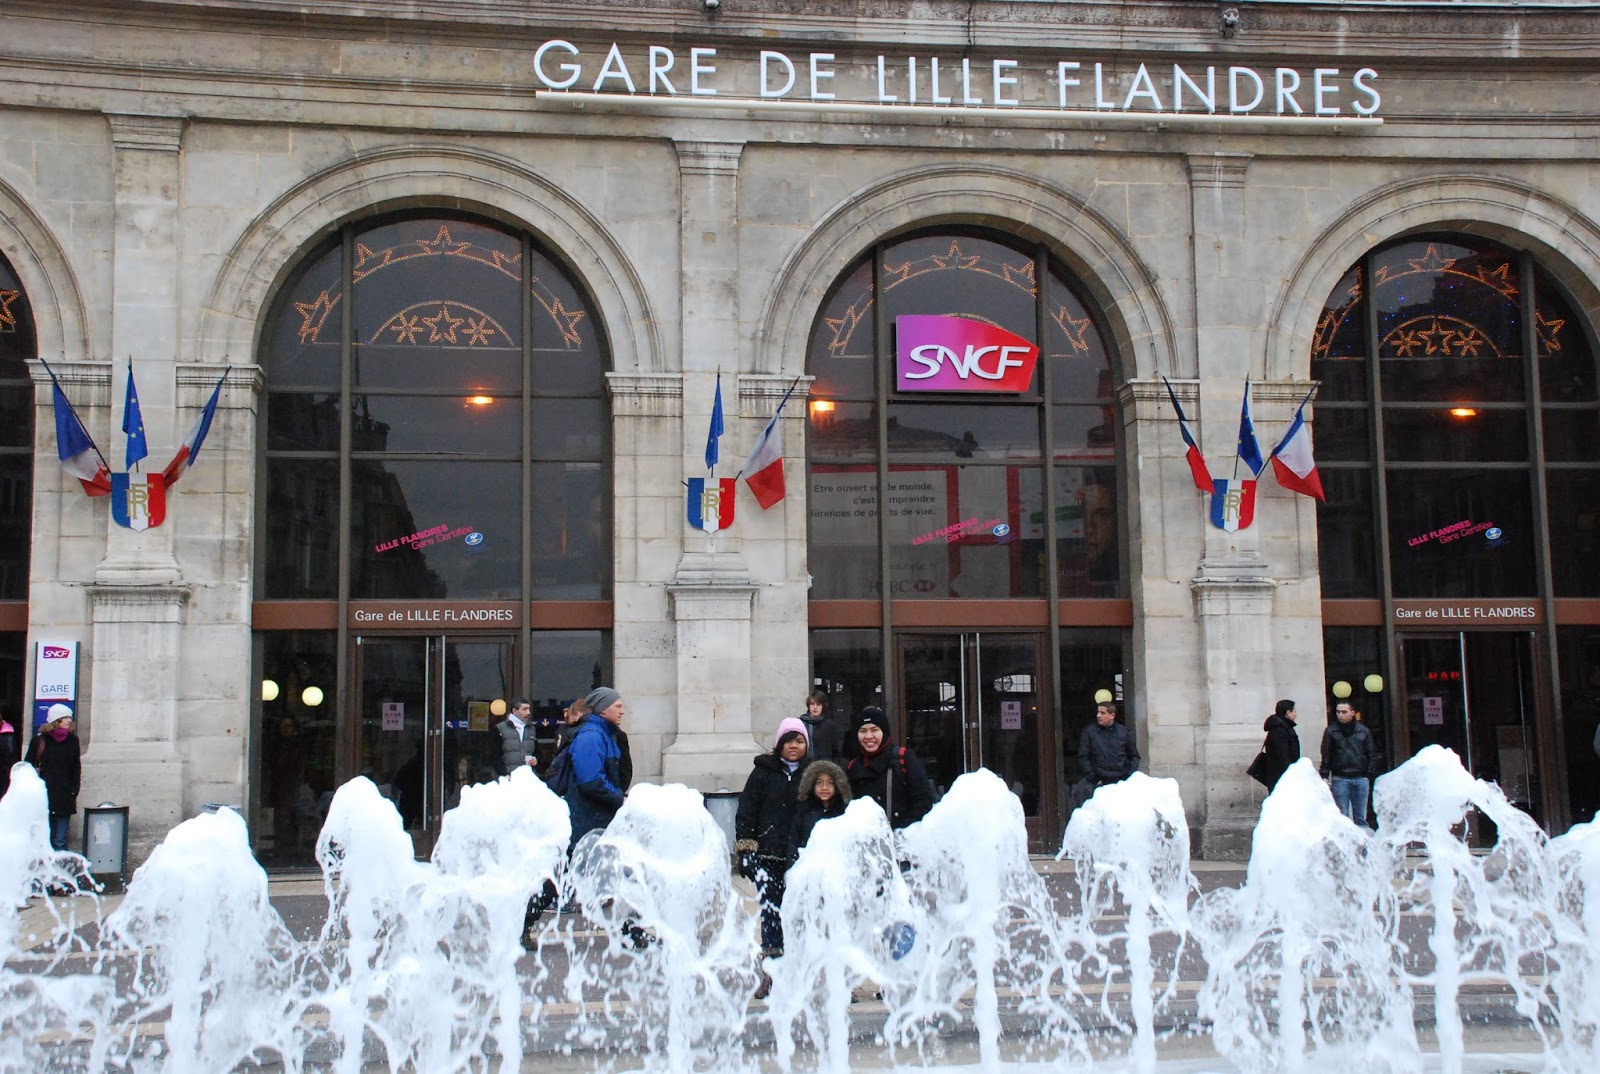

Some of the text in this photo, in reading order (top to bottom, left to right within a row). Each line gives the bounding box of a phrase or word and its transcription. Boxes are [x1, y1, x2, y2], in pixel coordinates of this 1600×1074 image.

[533, 39, 1381, 115] GARE DE LILLE FLANDRES
[904, 344, 1031, 380] SNCF
[836, 484, 867, 493] ouvert
[887, 483, 897, 491] le
[889, 494, 935, 505] mprendre
[854, 508, 867, 518] de
[901, 507, 913, 516] de
[375, 523, 448, 553] LILLE FLANDRES
[1408, 519, 1472, 547] LILLE FLANDRES
[1439, 532, 1460, 544] Gare
[411, 538, 435, 550] Gare
[354, 609, 513, 621] Gare de LILLE FLANDRES
[1396, 607, 1536, 618] Gare de LILLE FLANDRES
[44, 649, 69, 658] SNCF
[41, 684, 70, 693] GARE
